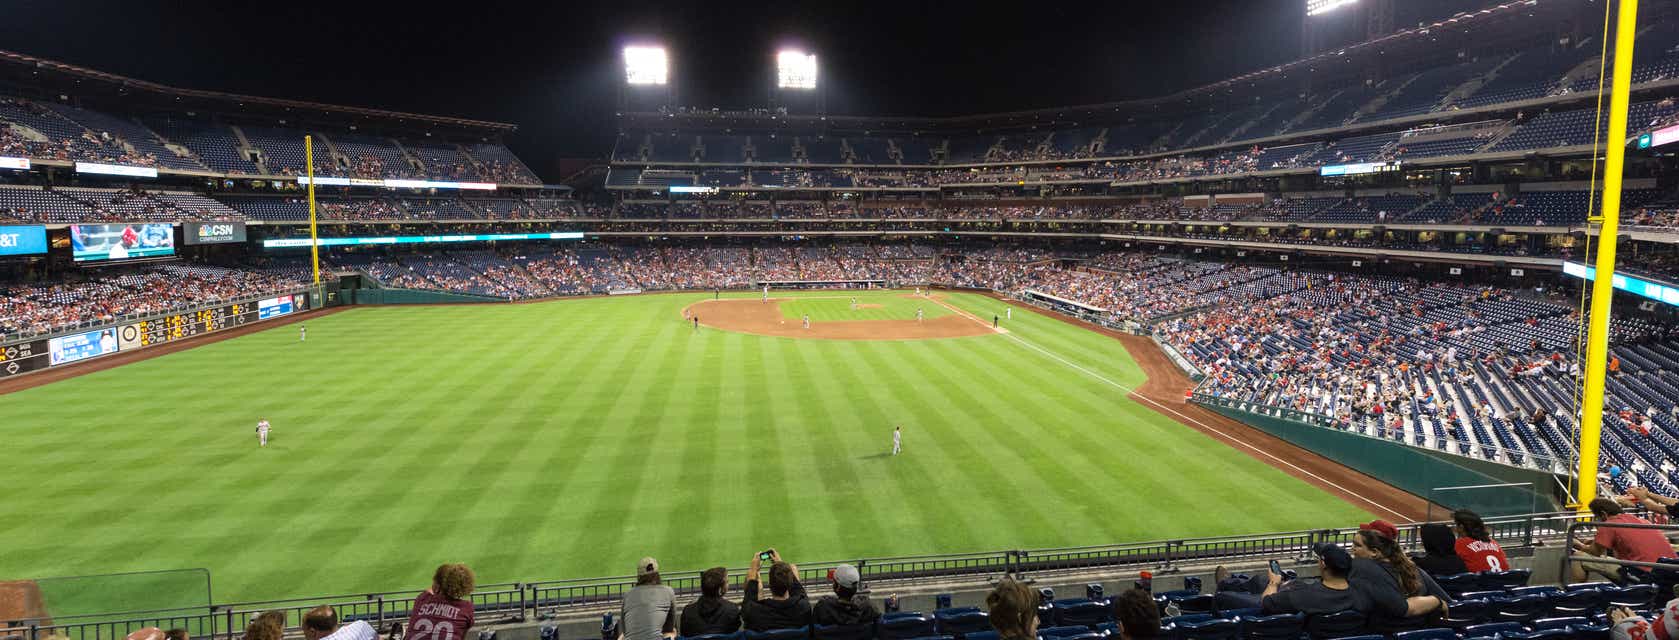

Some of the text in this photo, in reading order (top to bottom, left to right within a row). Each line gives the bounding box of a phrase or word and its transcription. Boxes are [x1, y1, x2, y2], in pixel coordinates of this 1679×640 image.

[213, 225, 233, 235] CSN
[1486, 555, 1502, 573] 8
[418, 603, 460, 619] SCHMIDT
[409, 619, 454, 640] 20
